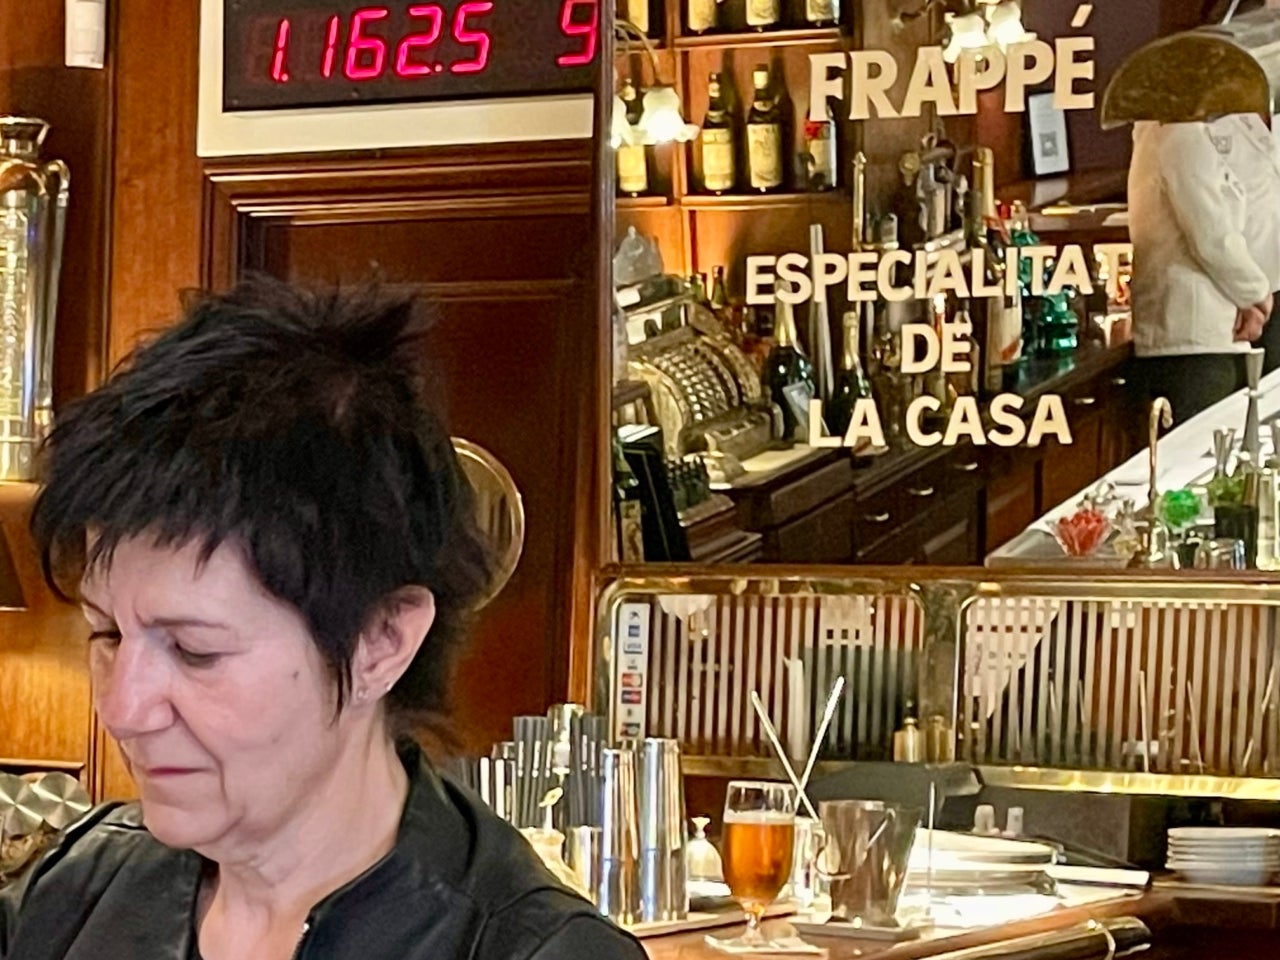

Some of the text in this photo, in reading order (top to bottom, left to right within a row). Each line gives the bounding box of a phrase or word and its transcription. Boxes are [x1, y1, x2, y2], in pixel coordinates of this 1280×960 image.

[808, 4, 1096, 122] FRAPPÉ
[745, 242, 1134, 306] ESPECIALITAT
[900, 322, 974, 375] DE
[808, 392, 1074, 448] LA CASA
